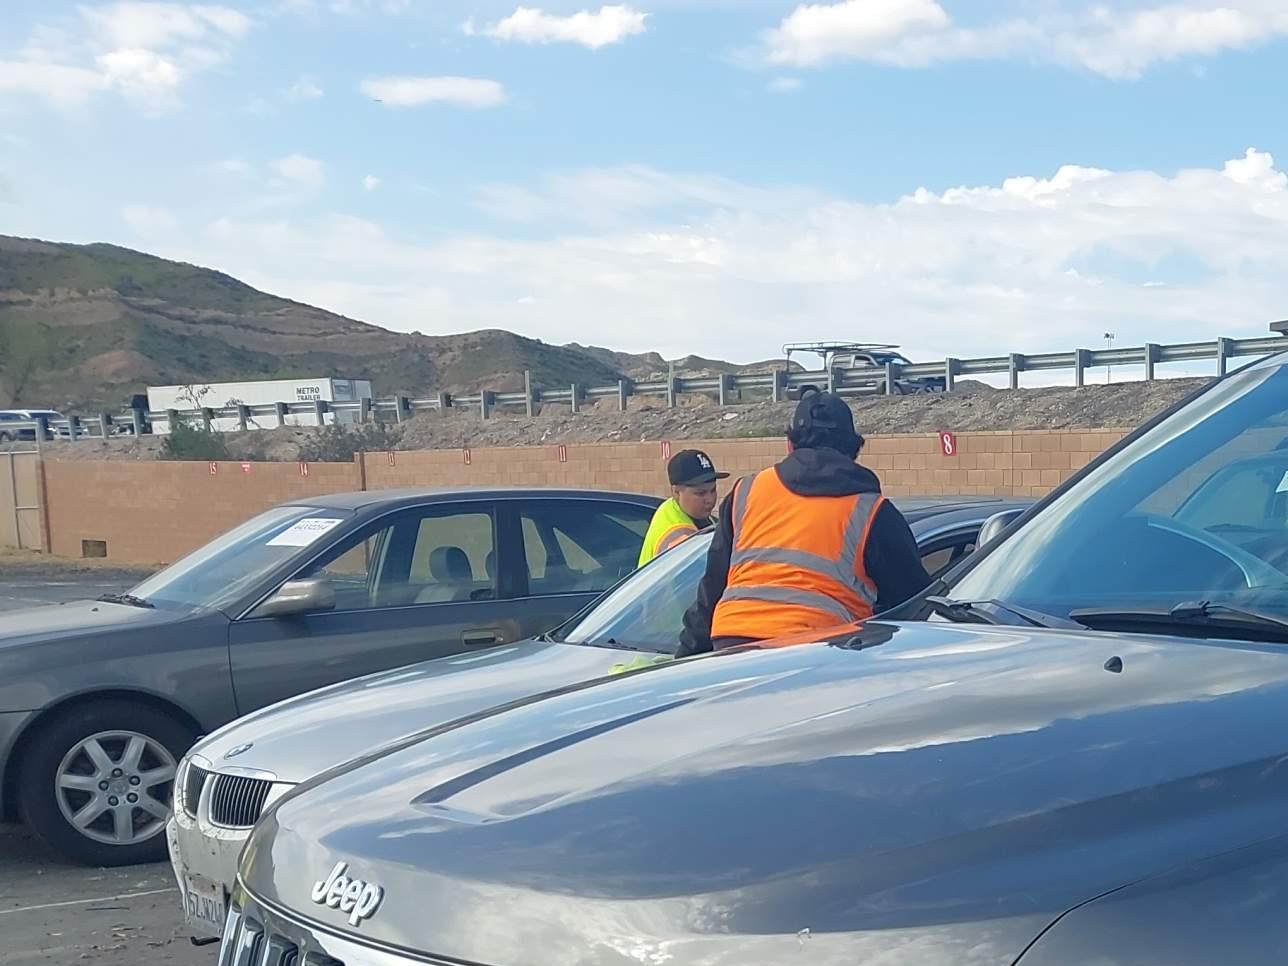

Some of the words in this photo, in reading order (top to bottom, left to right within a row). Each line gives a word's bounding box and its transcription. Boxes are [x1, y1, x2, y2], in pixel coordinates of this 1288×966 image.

[661, 442, 670, 460] 10
[943, 434, 953, 455] 8
[209, 462, 217, 475] 15
[697, 453, 711, 469] LA
[311, 860, 385, 928] Jeep
